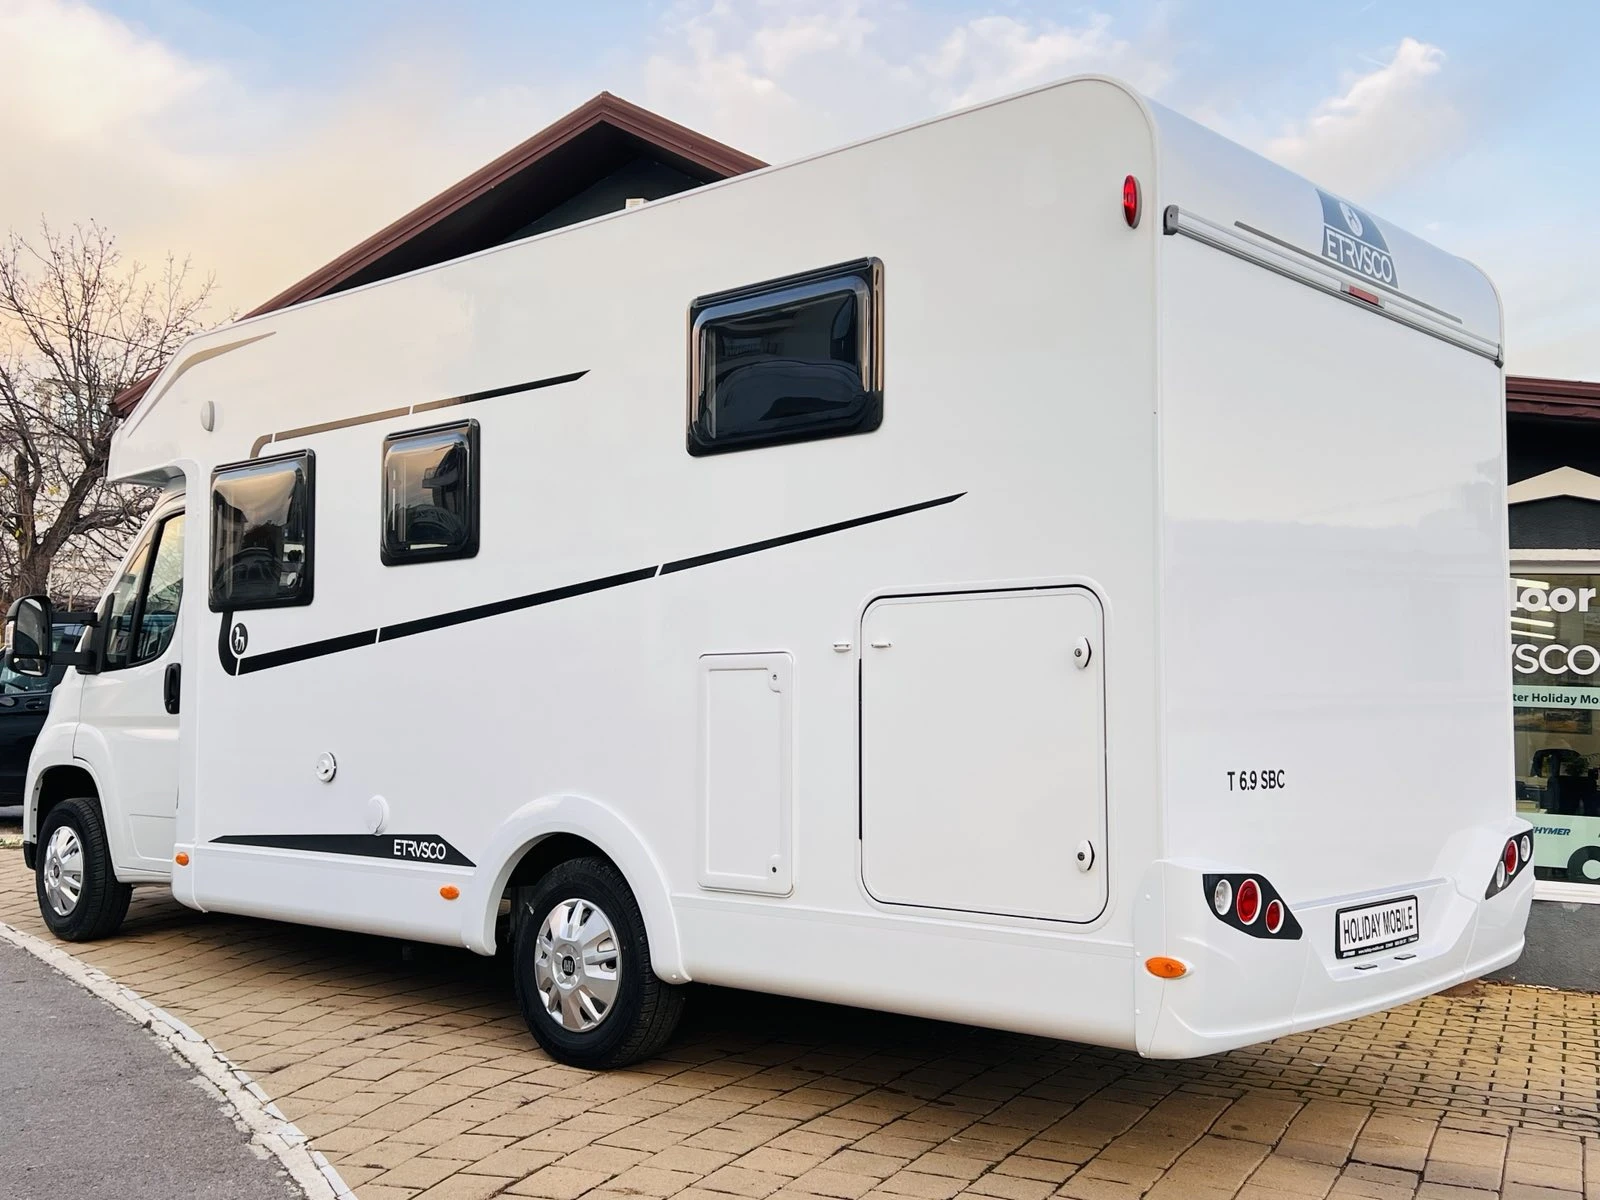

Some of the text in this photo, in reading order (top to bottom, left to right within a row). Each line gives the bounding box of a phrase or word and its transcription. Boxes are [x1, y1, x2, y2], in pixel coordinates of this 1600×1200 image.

[1511, 643, 1600, 675] SCO
[1531, 693, 1577, 706] Holiday
[1227, 769, 1285, 791] T 6.9 SBC
[1533, 826, 1571, 836] HYMER
[1343, 906, 1414, 945] HOLIDAY MOBILE
